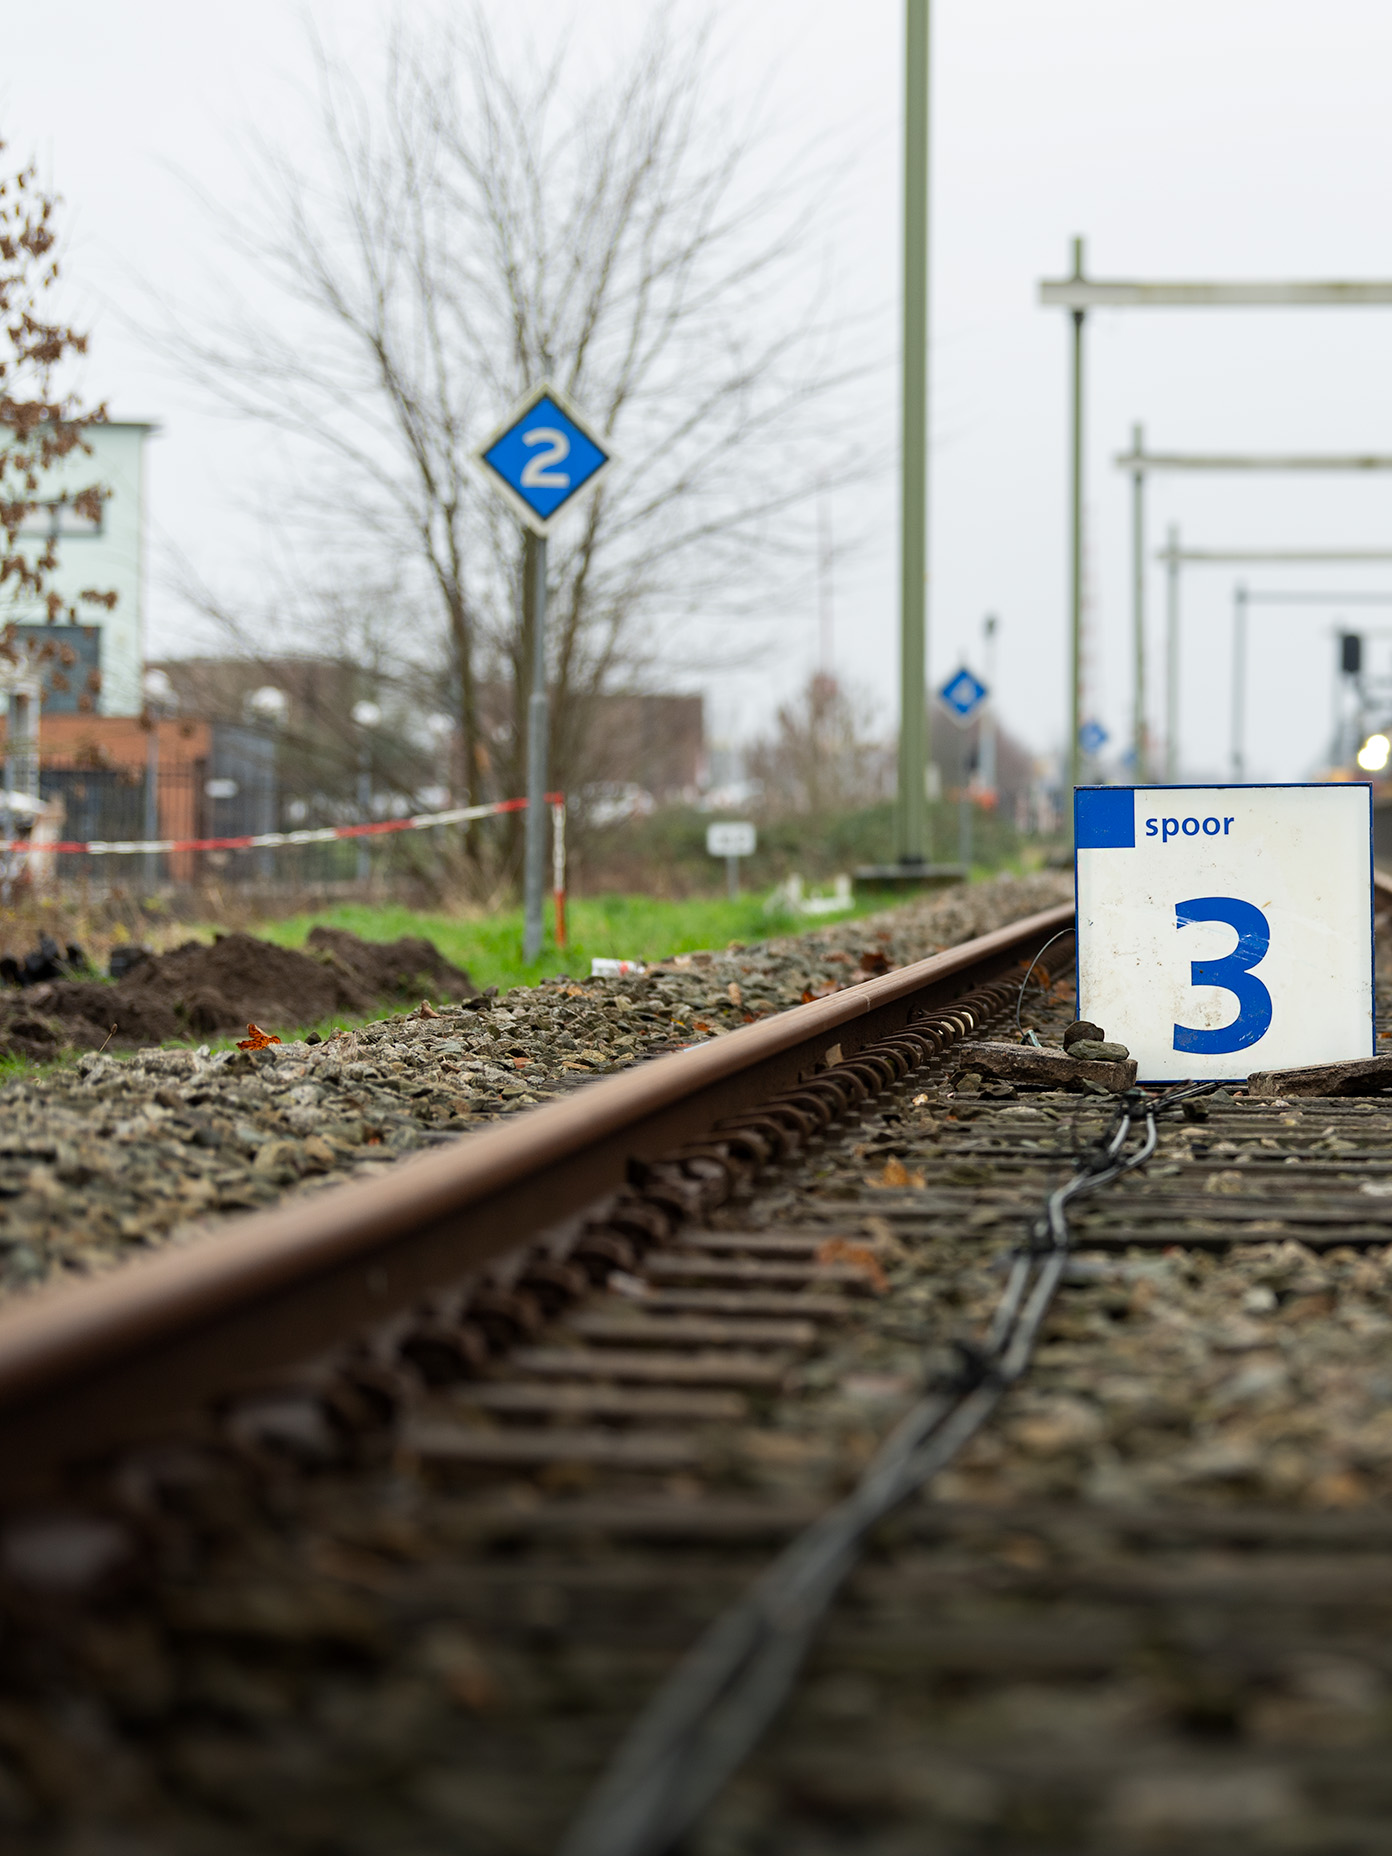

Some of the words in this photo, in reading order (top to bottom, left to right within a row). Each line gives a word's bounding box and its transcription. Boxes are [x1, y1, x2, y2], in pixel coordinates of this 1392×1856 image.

[520, 427, 571, 489] 2
[1145, 816, 1235, 843] spoor
[1172, 896, 1273, 1055] 3
